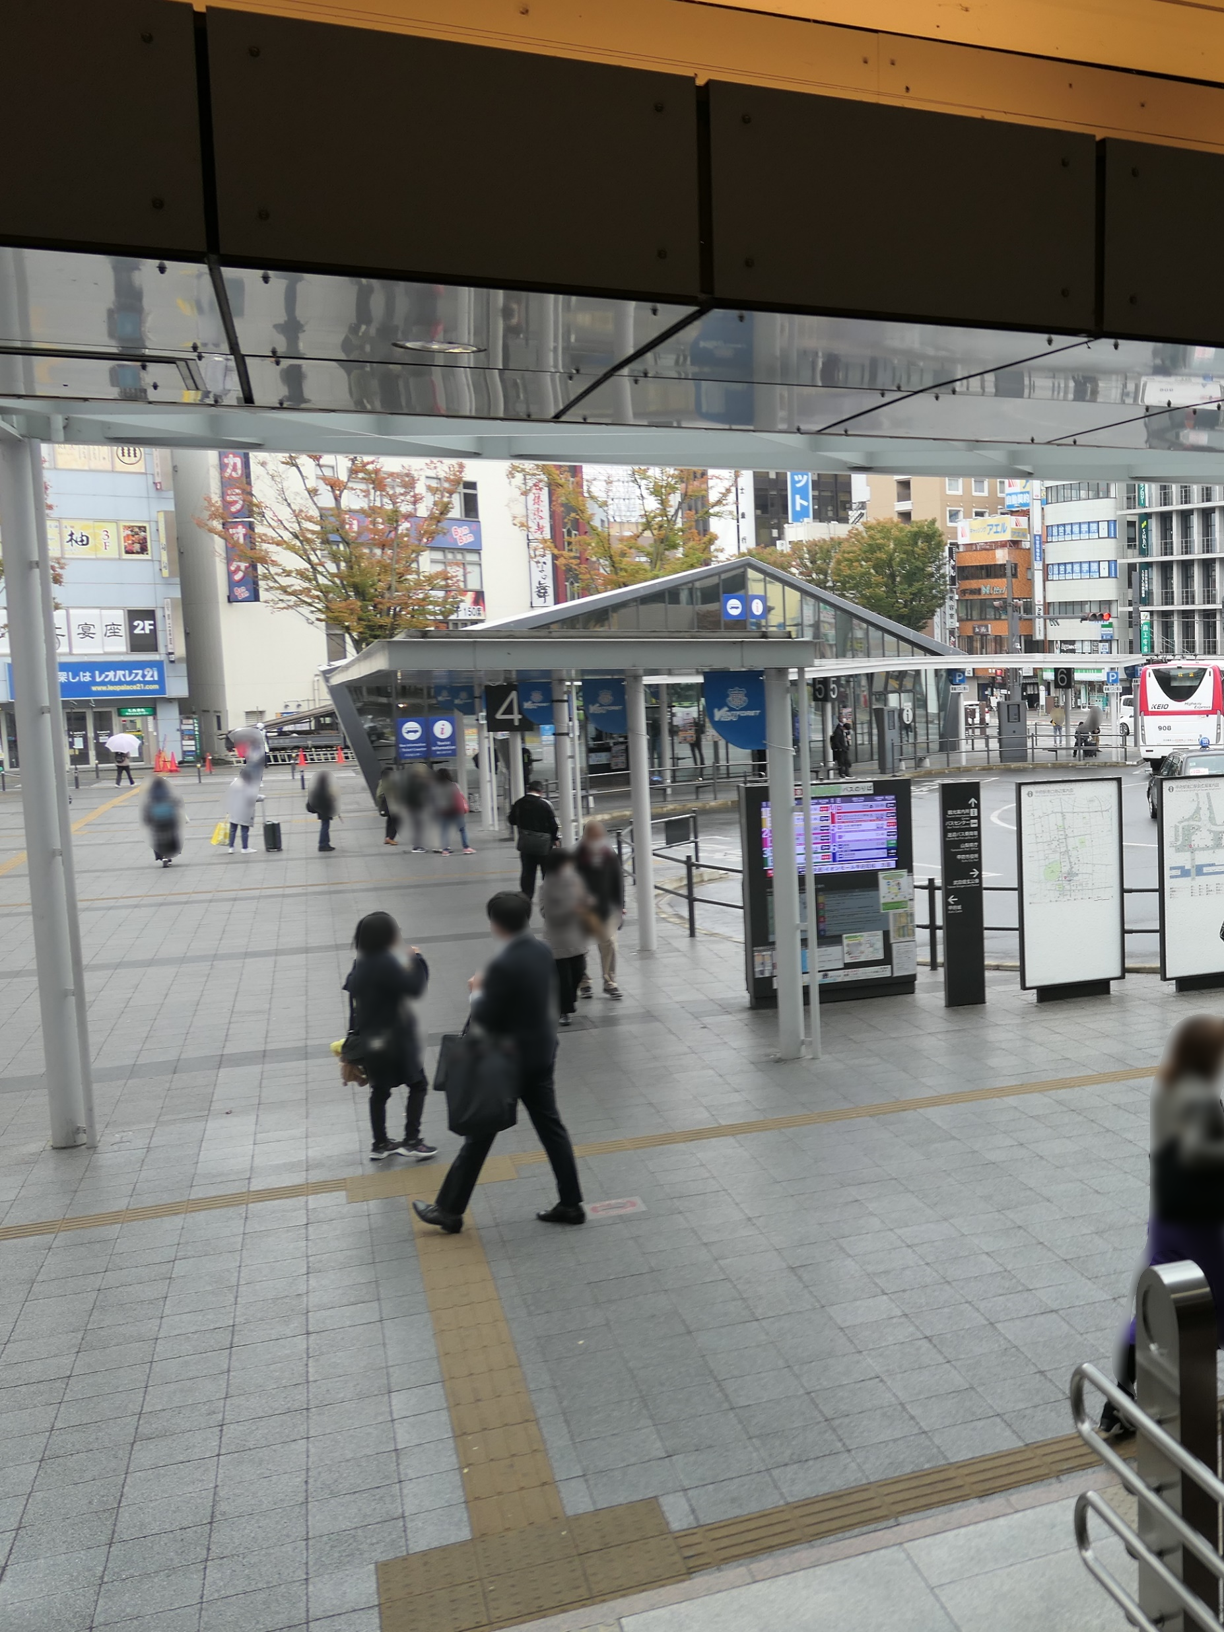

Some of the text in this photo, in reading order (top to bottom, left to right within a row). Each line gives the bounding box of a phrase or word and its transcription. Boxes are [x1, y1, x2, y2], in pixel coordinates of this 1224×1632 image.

[793, 474, 809, 511] ット
[986, 522, 1008, 536] アエル
[66, 530, 90, 547] 柚
[133, 620, 155, 634] 2F
[1057, 669, 1068, 686] 6
[91, 683, 160, 692] www.leopalace21.com
[830, 678, 838, 699] 5
[495, 691, 522, 726] 4
